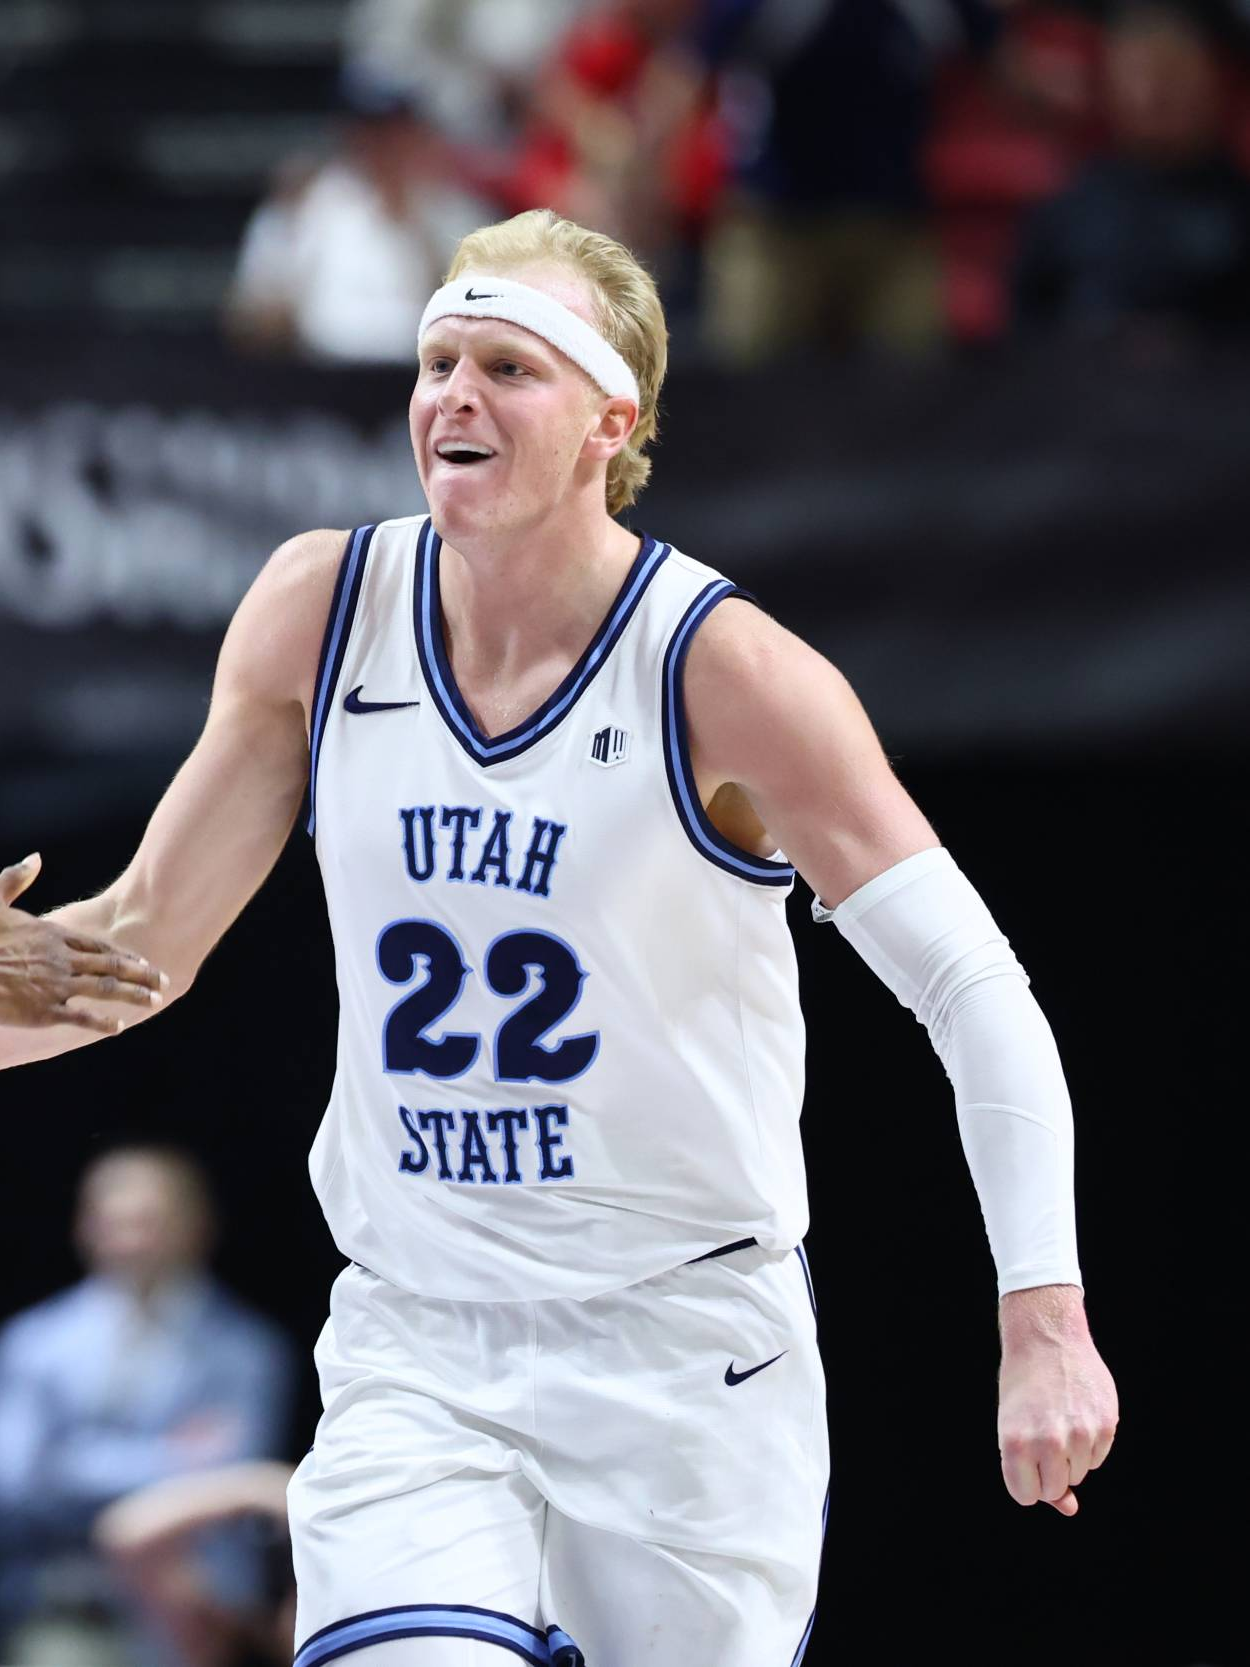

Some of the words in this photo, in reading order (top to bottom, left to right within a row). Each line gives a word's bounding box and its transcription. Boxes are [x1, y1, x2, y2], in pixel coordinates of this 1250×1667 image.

[398, 805, 567, 898] UTAH
[375, 917, 600, 1084] 22
[398, 1104, 575, 1184] STATE
